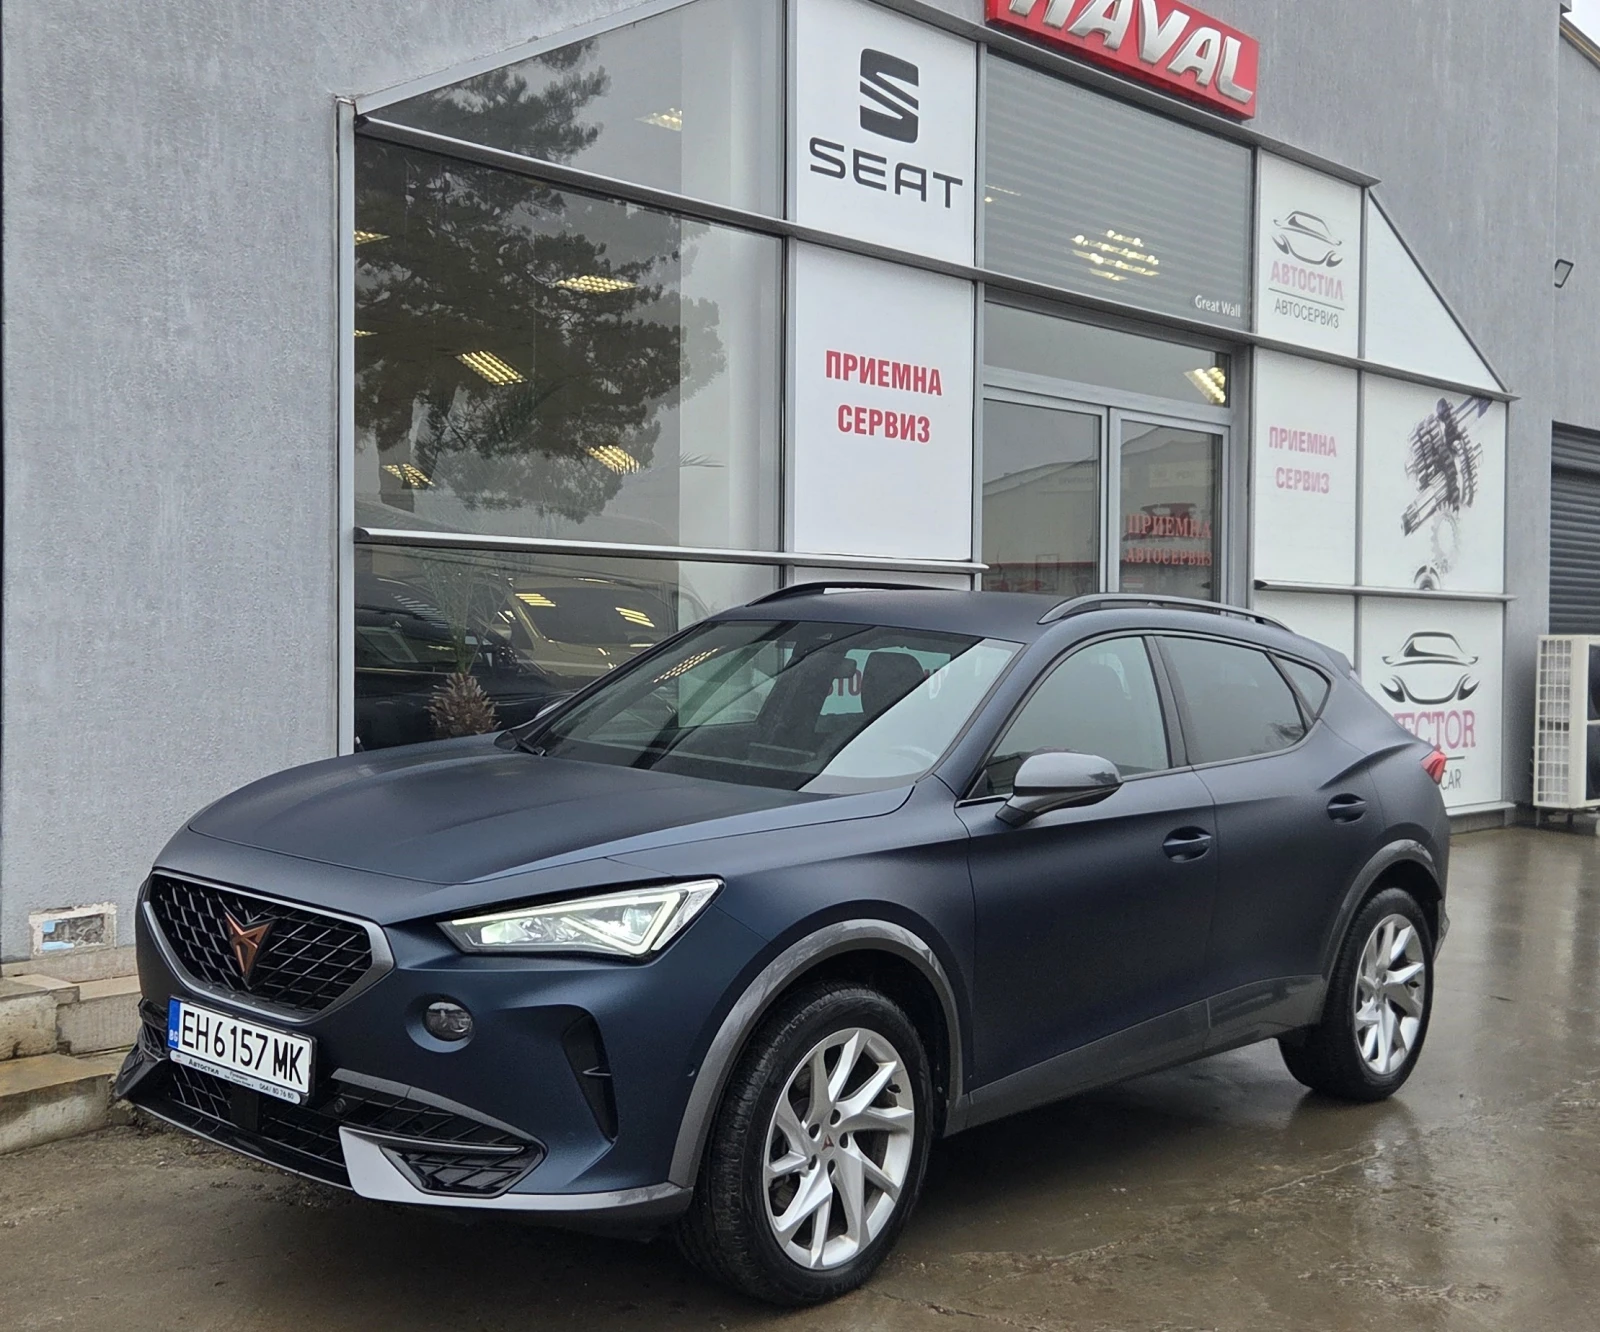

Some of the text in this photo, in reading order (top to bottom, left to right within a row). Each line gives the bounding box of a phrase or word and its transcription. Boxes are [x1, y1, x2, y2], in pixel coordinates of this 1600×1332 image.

[809, 136, 963, 209] SEAT
[1270, 260, 1344, 301] АВТОСТИЛ
[1194, 295, 1241, 317] Great Wall
[1274, 301, 1340, 329] АВТОСЕРВИЗ
[826, 350, 942, 396] ПРИЕМНА
[837, 404, 931, 443] СЕРВИЗ
[1268, 426, 1337, 457] ПРИЕМНА
[1275, 467, 1330, 494] СЕРВИЗ
[1128, 513, 1212, 538] ПРИЕМНА
[1125, 547, 1213, 566] АВТОСЕРВИЗ
